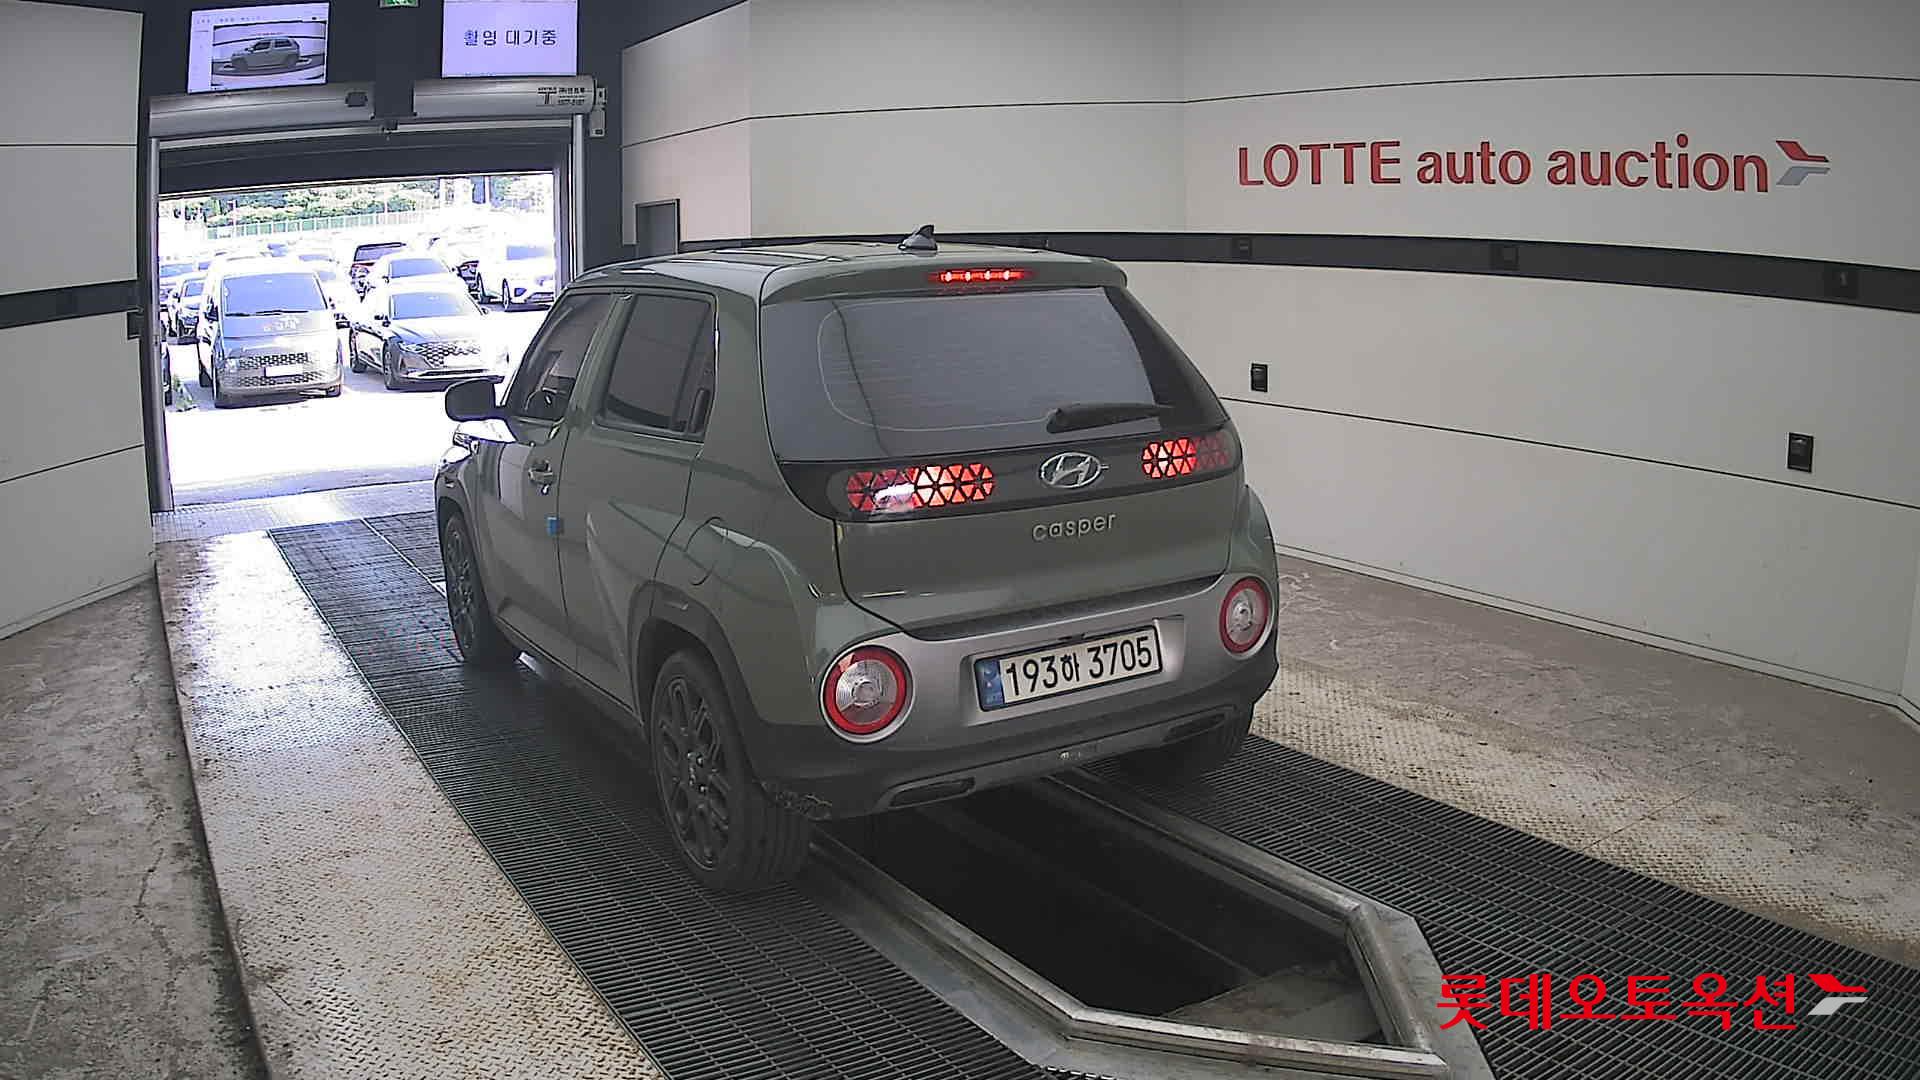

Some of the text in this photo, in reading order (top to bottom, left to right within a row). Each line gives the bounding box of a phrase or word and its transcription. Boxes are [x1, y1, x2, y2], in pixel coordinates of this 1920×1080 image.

[506, 29, 557, 46] 대기중
[1238, 133, 1769, 193] LOTTE auto auction
[1032, 514, 1117, 541] casper
[1006, 636, 1151, 696] 193하 3705
